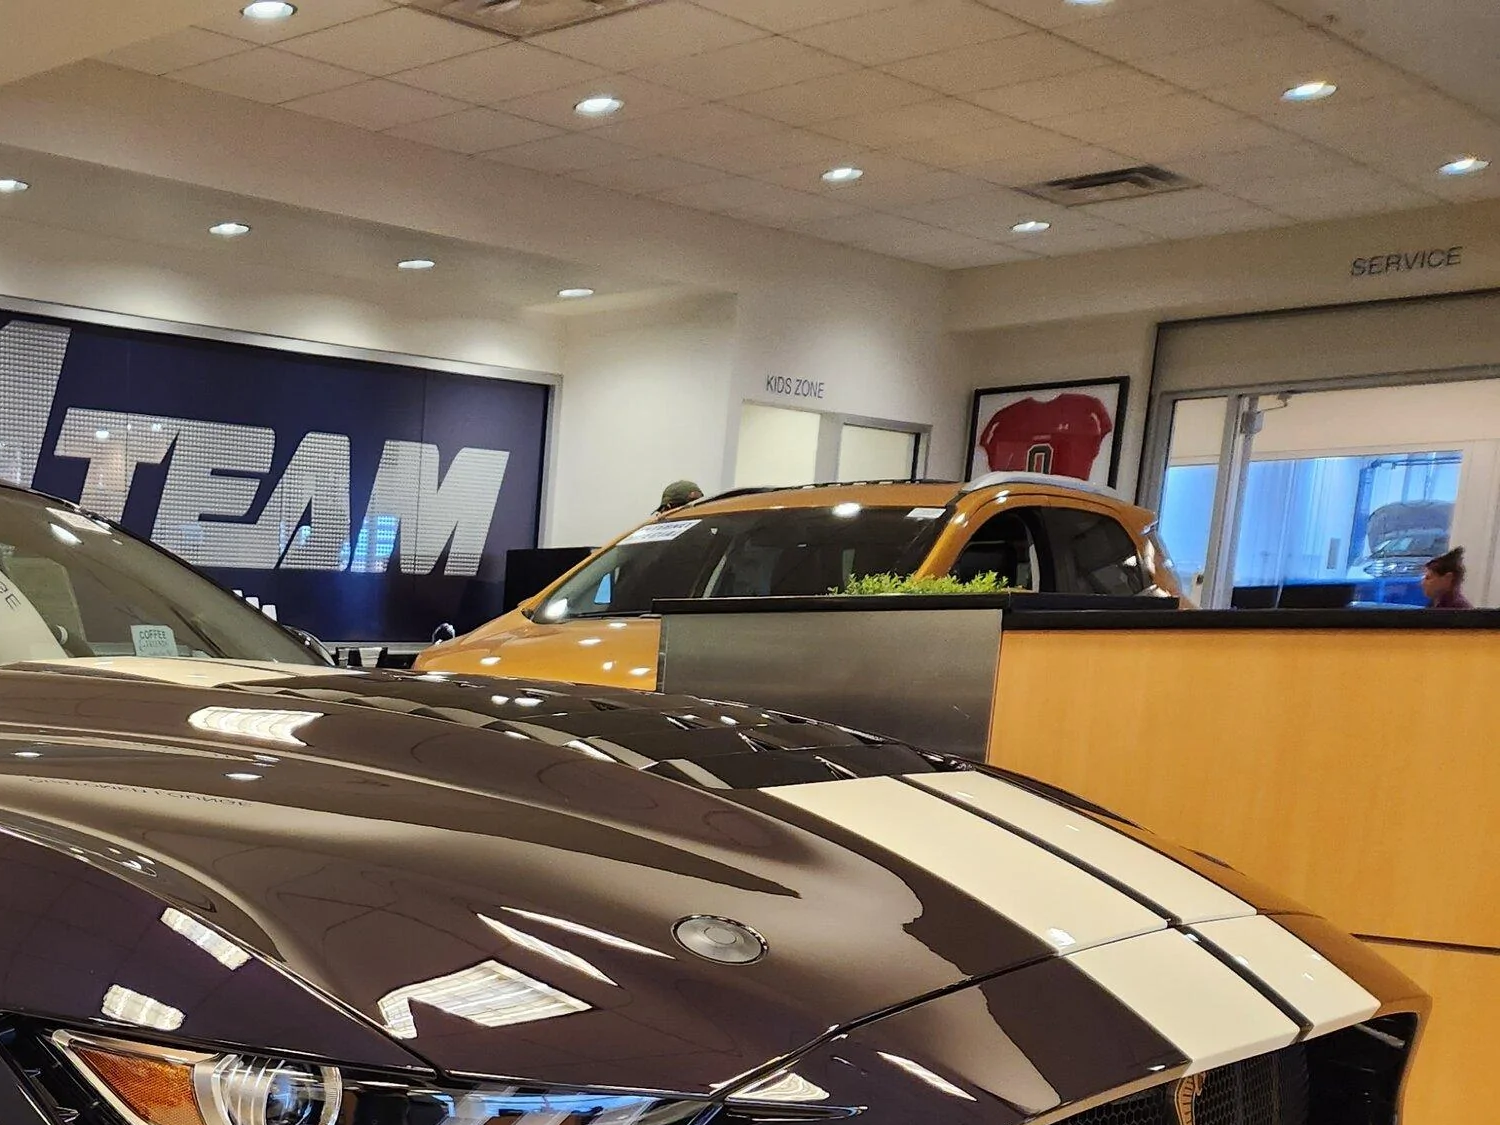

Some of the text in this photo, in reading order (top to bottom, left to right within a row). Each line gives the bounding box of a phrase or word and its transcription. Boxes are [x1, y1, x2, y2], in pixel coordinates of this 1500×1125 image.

[1350, 245, 1463, 277] SERVICE
[765, 375, 825, 399] KIDS ZONE
[53, 406, 511, 577] TEAM
